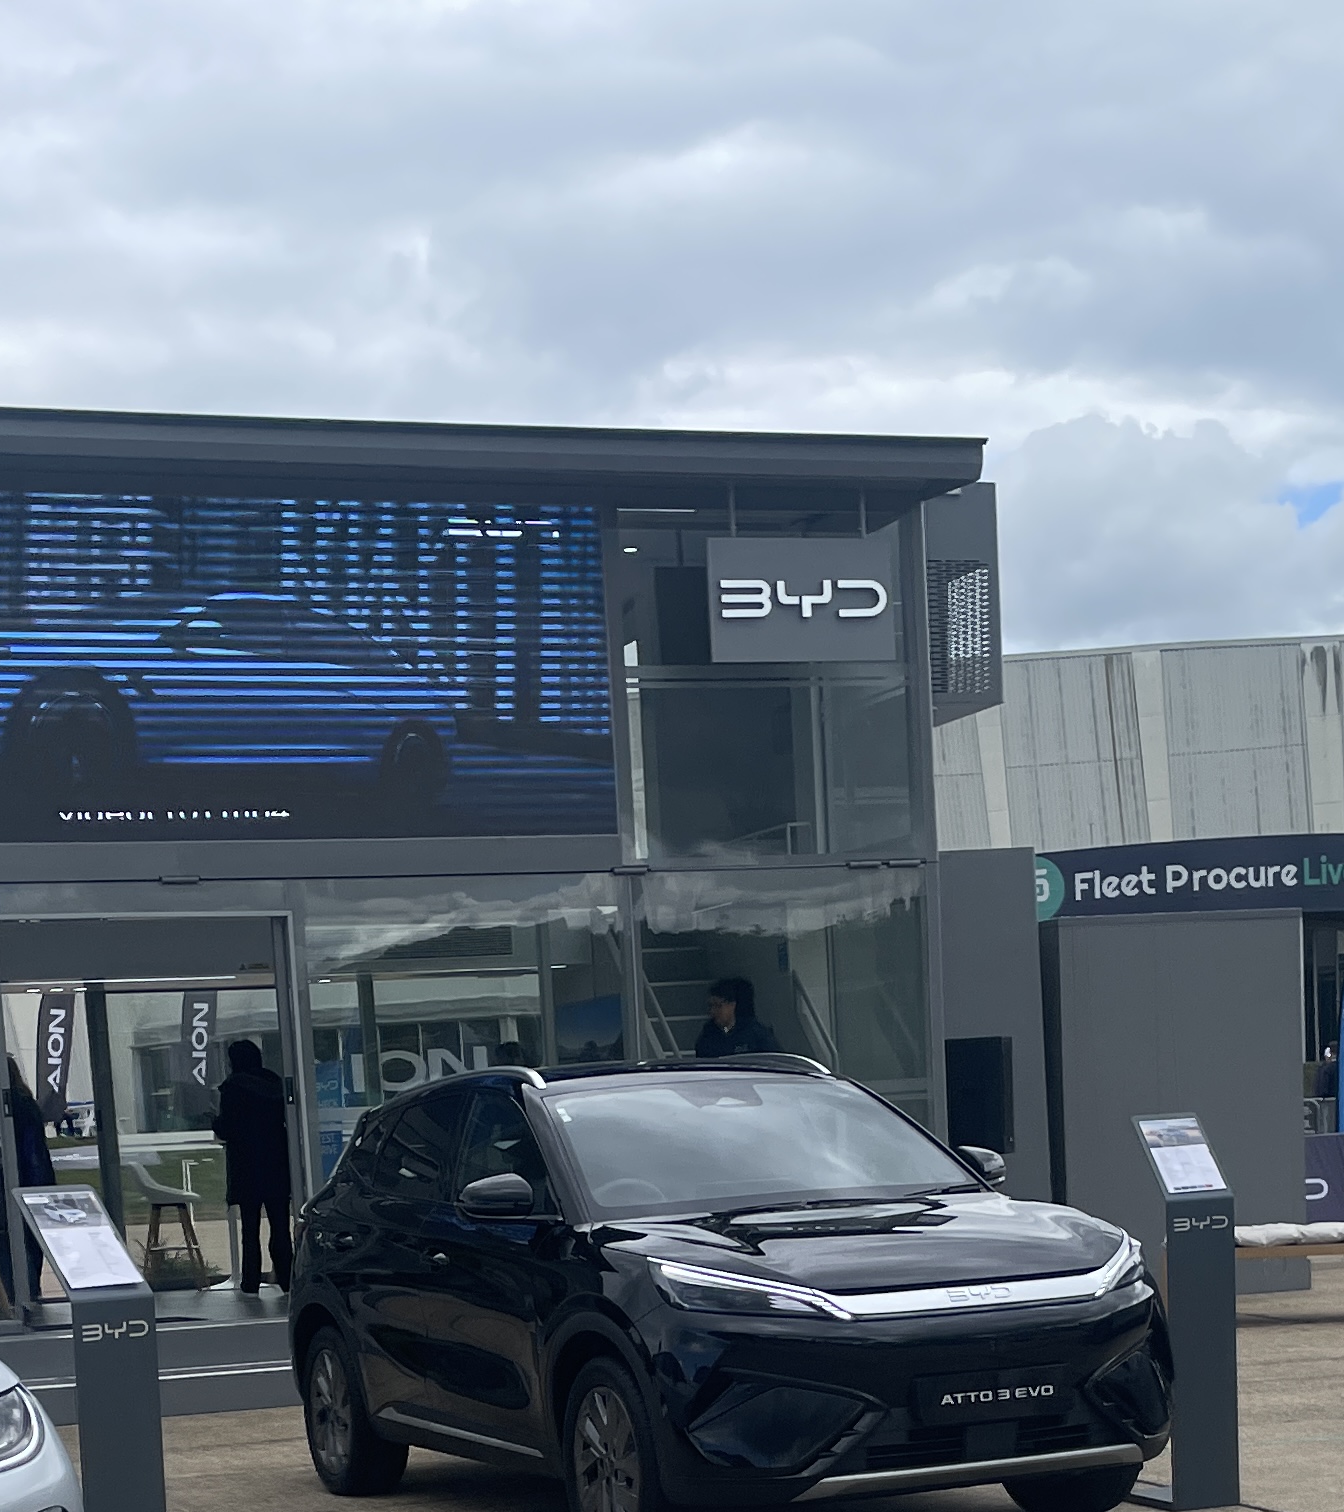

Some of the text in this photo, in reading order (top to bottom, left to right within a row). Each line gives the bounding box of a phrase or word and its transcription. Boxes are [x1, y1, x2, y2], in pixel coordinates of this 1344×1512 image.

[719, 578, 888, 618] BYD
[1074, 865, 1157, 901] Fleet
[1165, 863, 1298, 894] Procure
[47, 1008, 66, 1094] AION
[191, 1002, 209, 1086] AION
[347, 1045, 489, 1094] ION
[1173, 1215, 1229, 1232] BYD
[946, 1285, 1012, 1303] BYD
[81, 1319, 149, 1342] BYD
[940, 1384, 1055, 1406] ATTO 3 EVO
